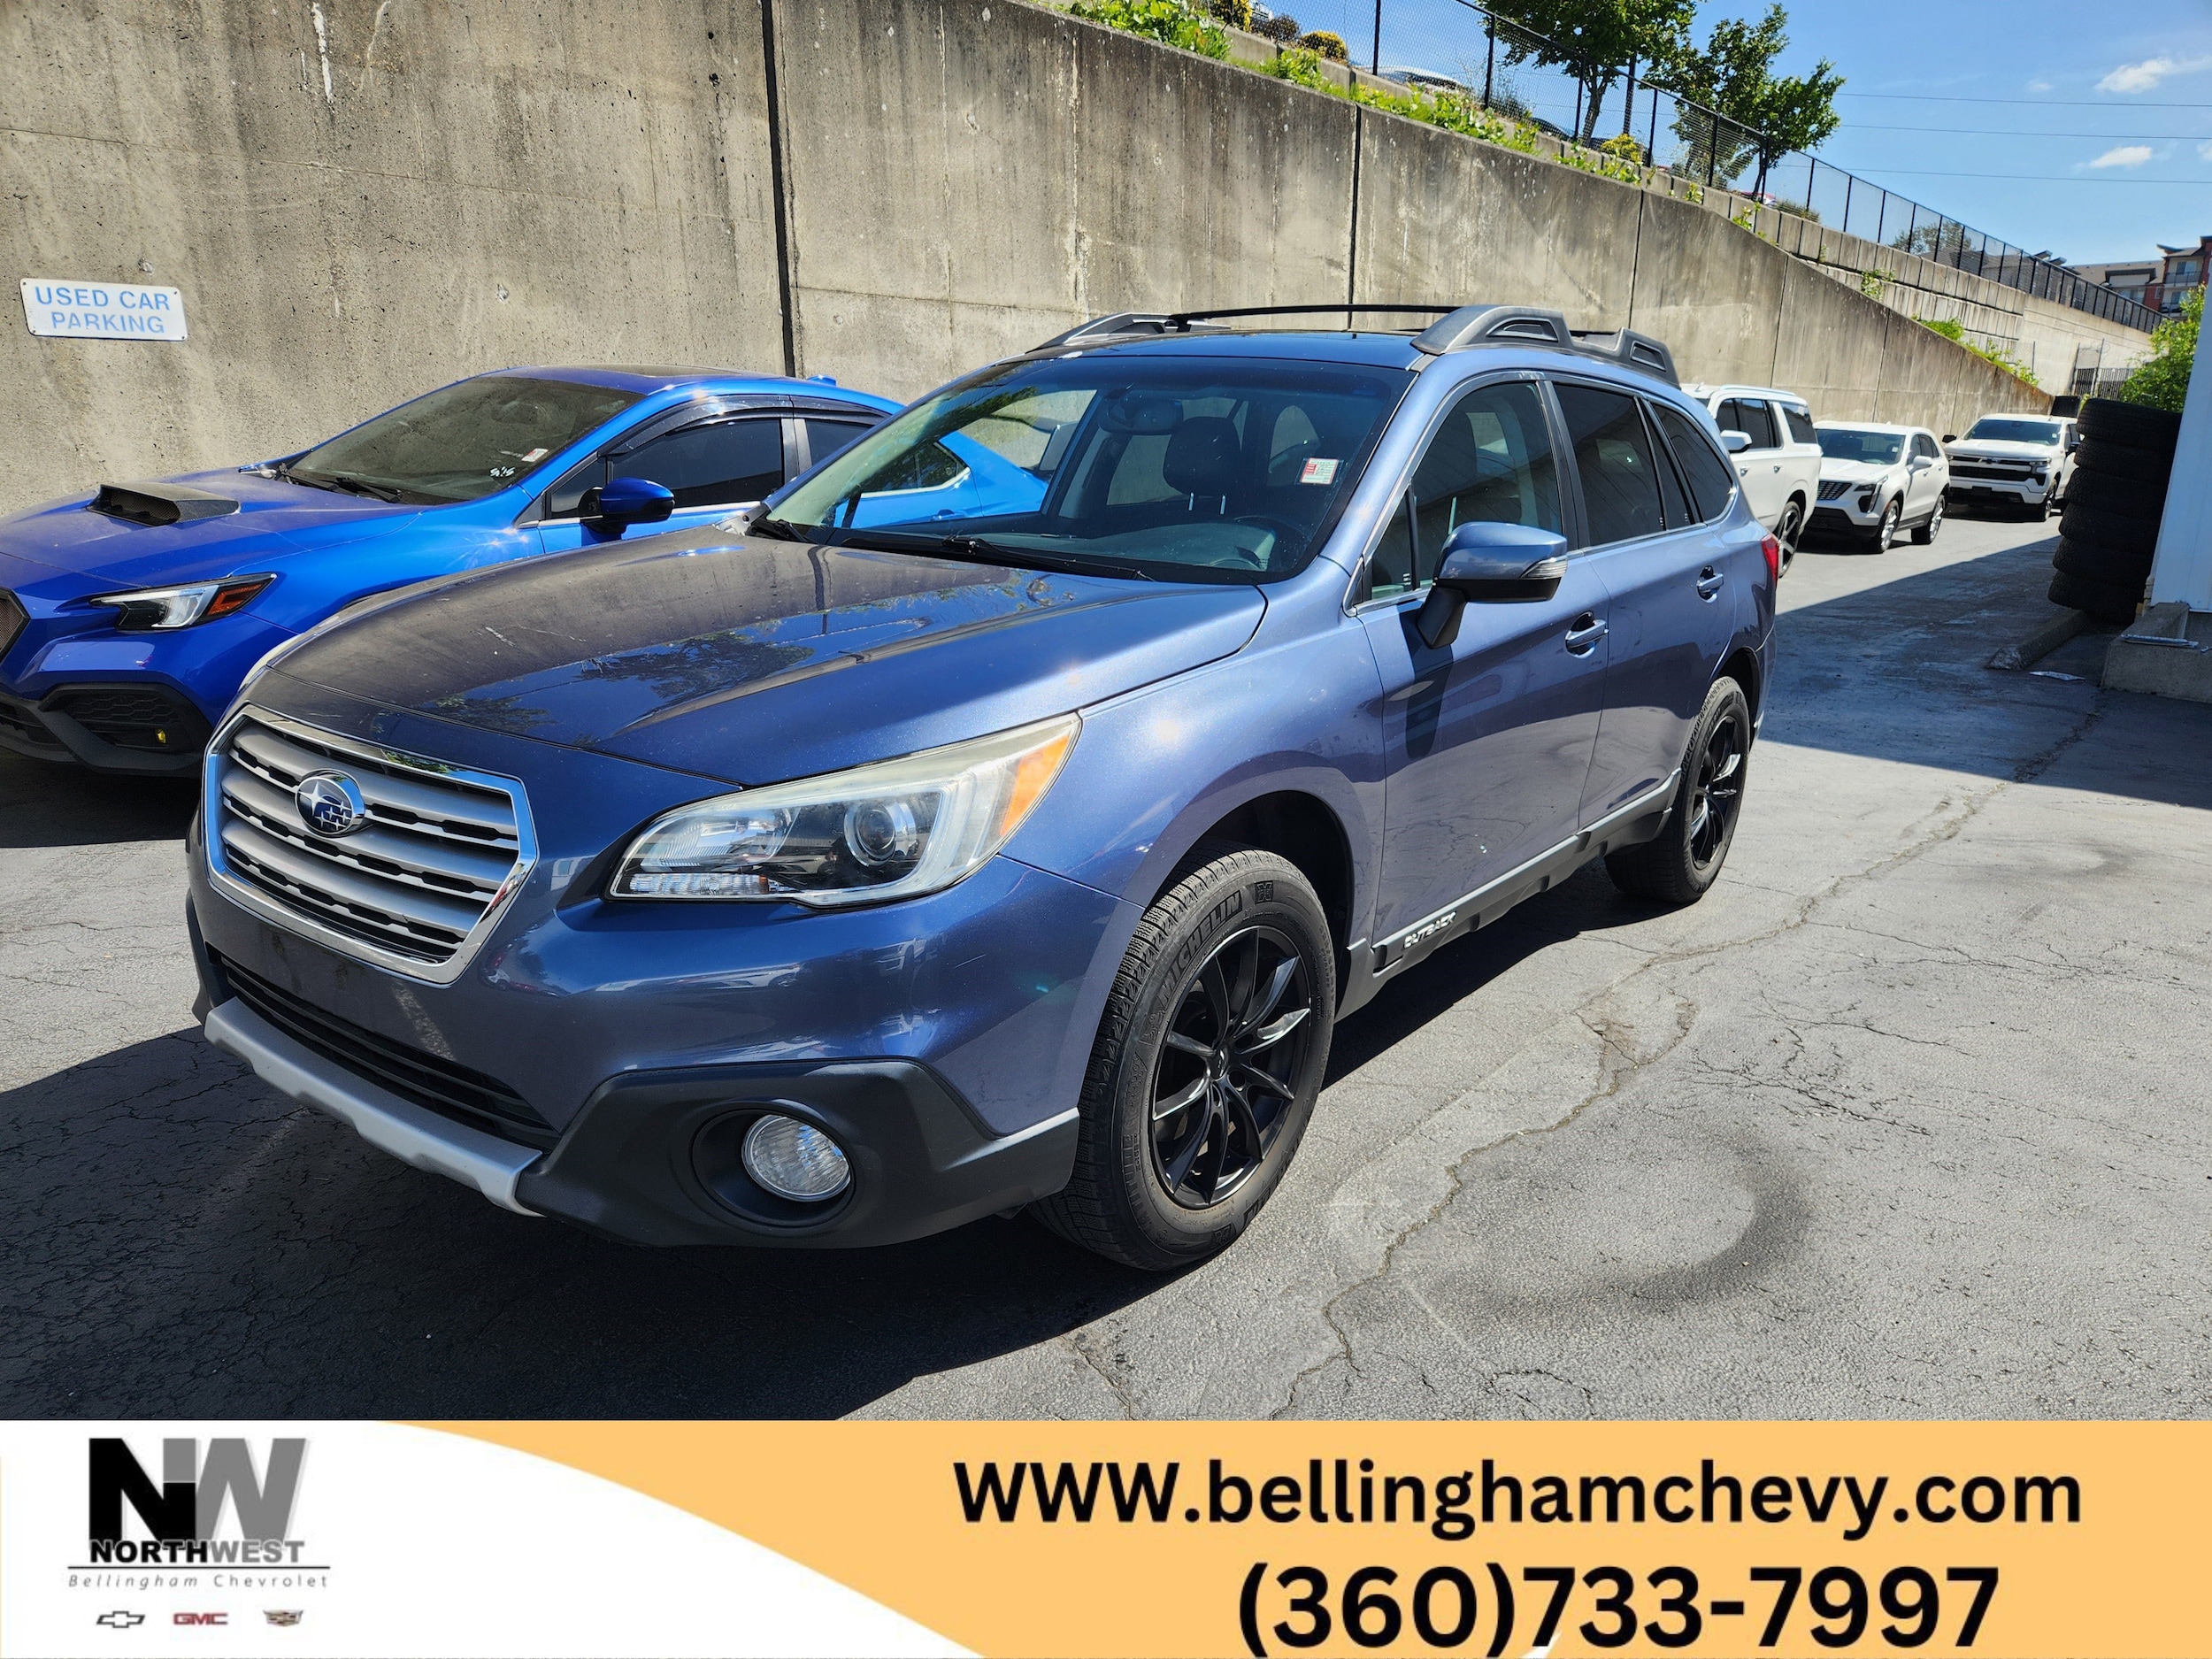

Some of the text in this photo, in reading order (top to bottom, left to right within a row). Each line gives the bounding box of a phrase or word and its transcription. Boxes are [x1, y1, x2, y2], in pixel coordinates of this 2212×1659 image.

[35, 287, 171, 311] USED CAR
[50, 311, 165, 334] PARKING
[1403, 911, 1457, 949] OUTBACK
[1156, 891, 1240, 1007] MICHELIN
